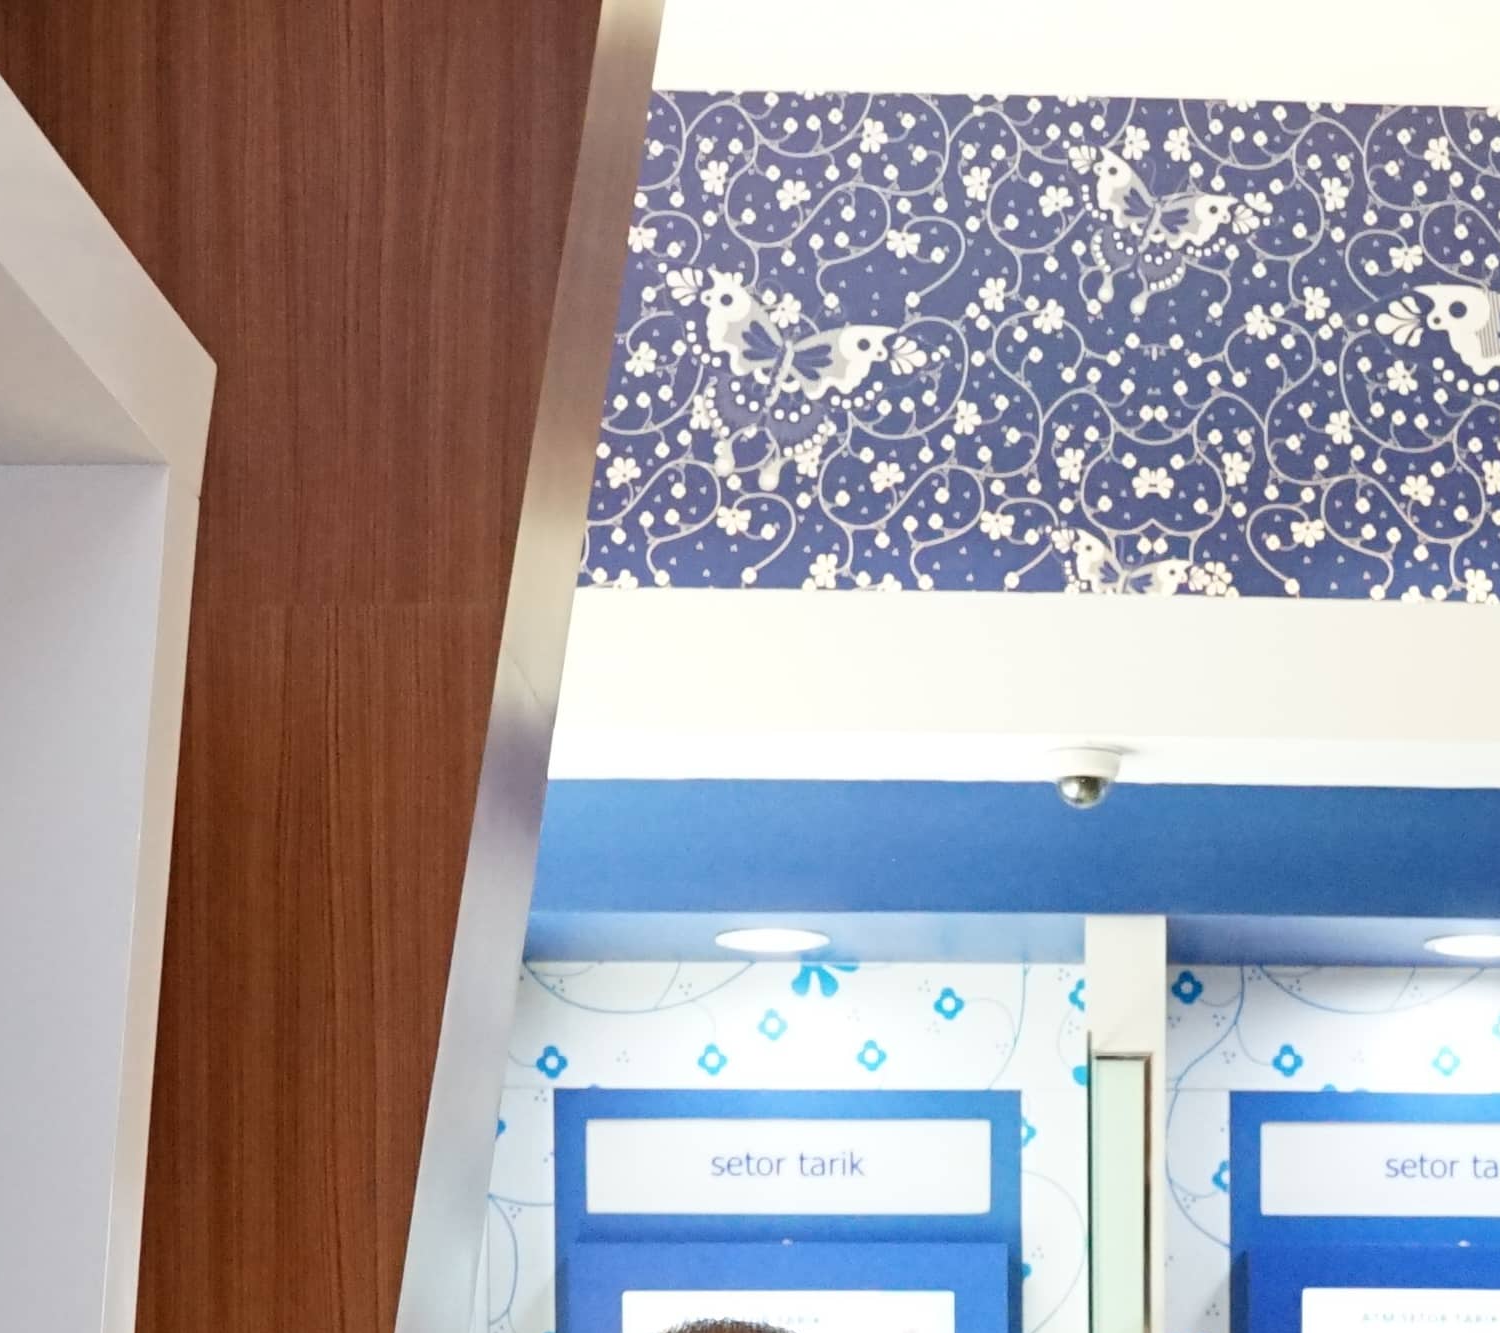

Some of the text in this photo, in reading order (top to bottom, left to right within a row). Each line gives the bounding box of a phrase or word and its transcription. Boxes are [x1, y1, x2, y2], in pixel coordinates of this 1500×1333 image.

[711, 1151, 864, 1177] setor tarik
[1385, 1154, 1460, 1180] setor
